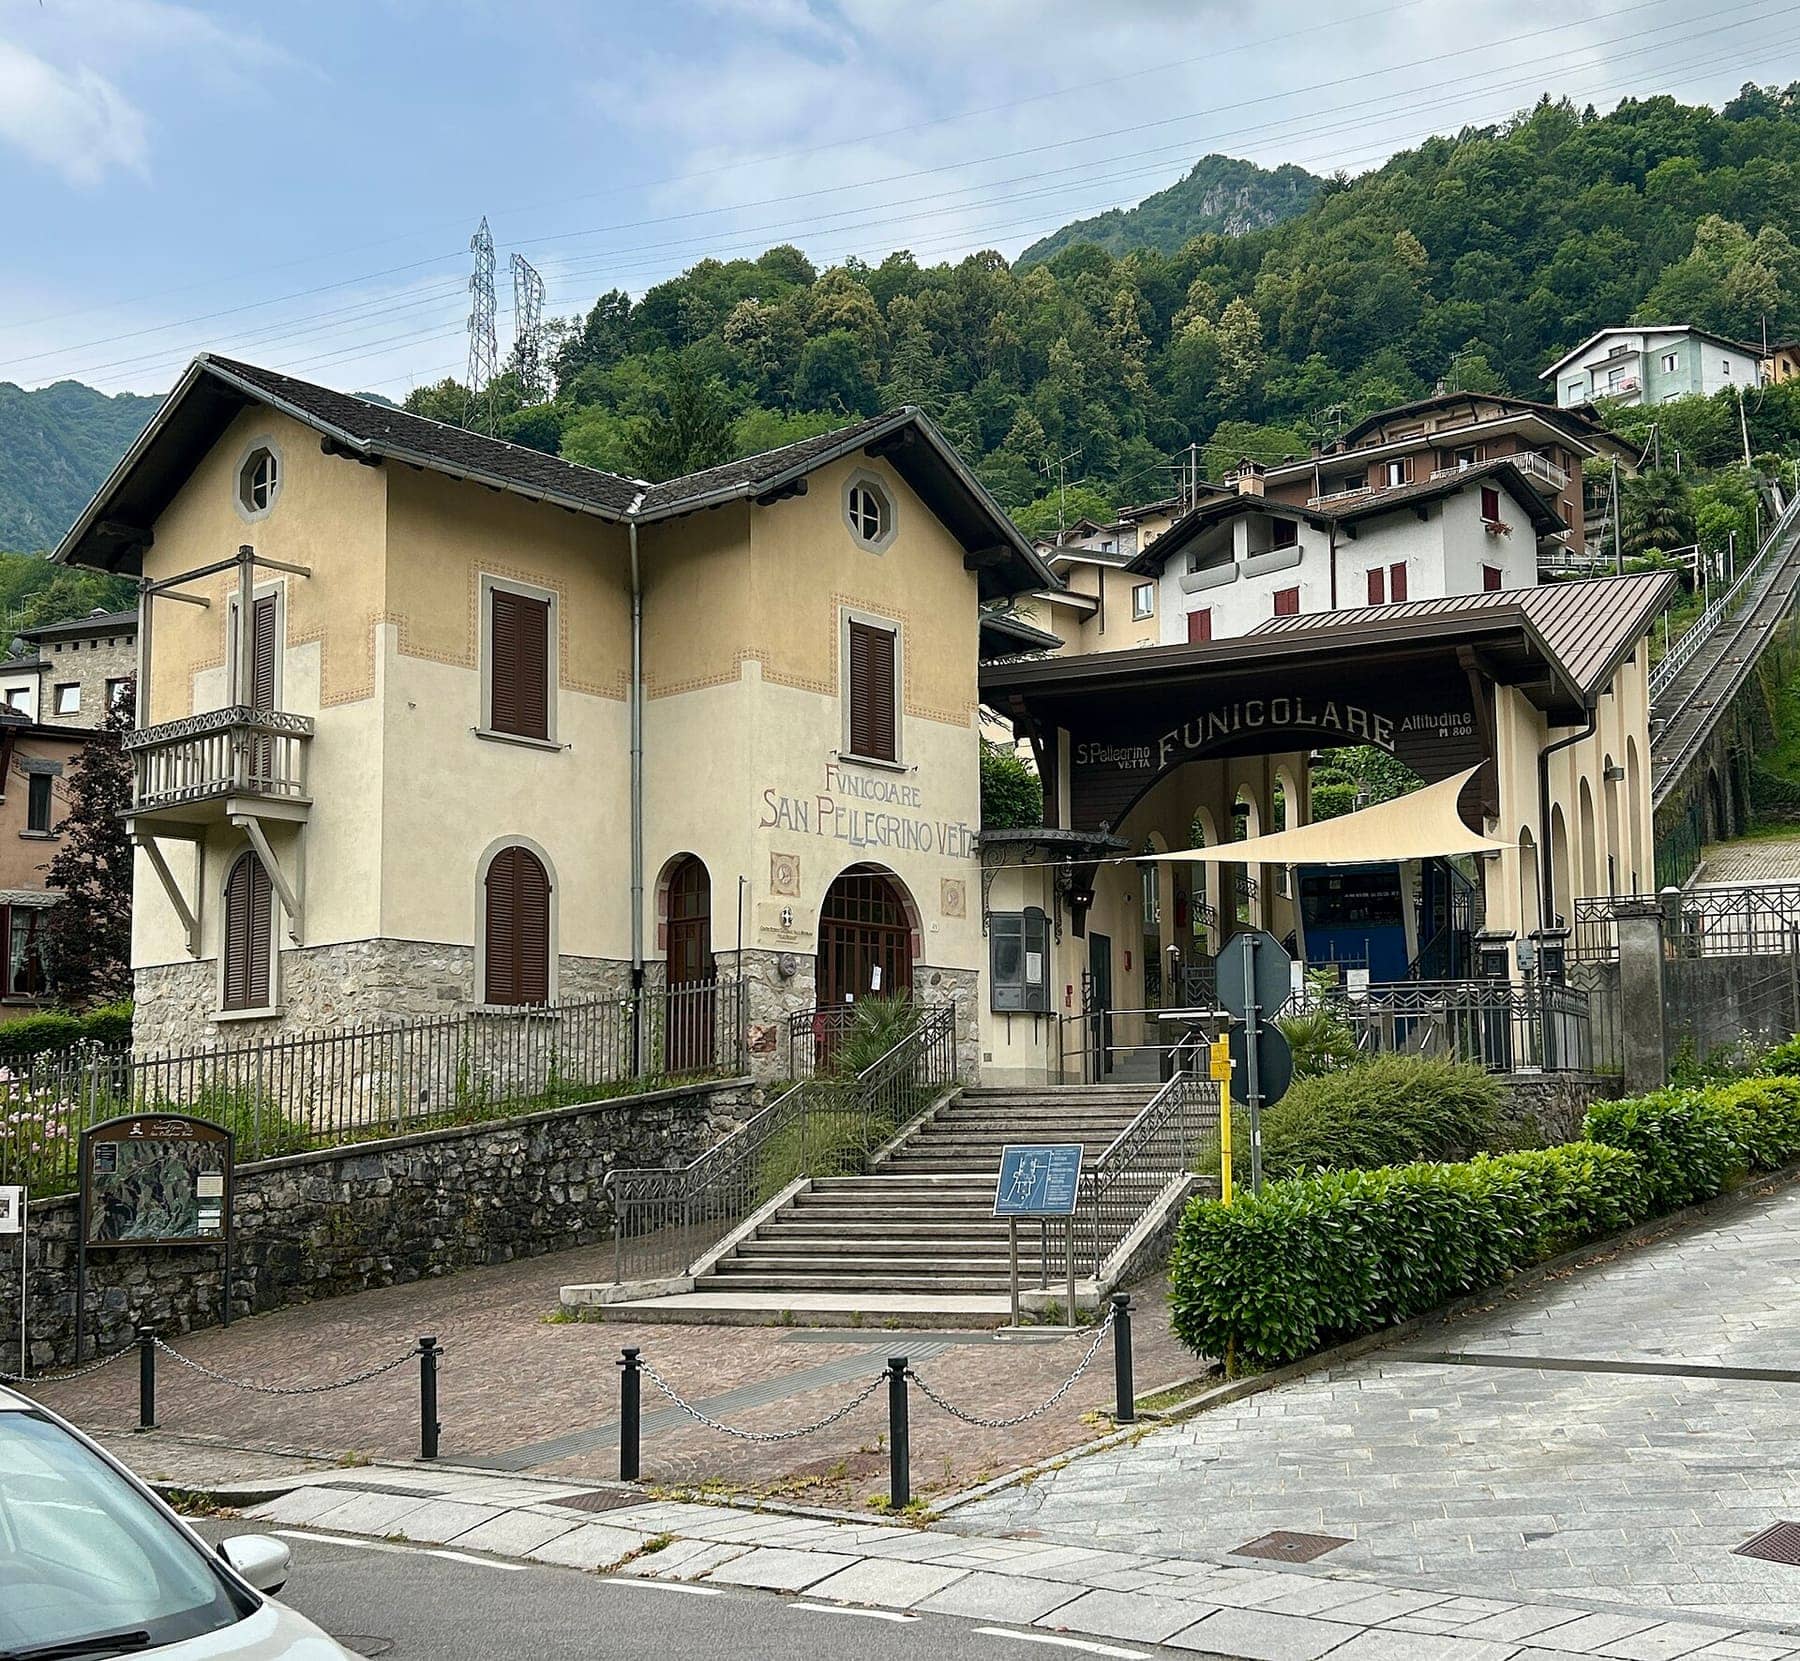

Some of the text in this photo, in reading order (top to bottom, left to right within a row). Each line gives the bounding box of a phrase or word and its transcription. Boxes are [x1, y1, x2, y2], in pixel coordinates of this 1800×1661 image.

[1401, 712, 1472, 732] Altitudine
[1452, 726, 1473, 736] 800
[1157, 697, 1395, 771] FUNICOLARE
[1118, 758, 1151, 770] VETTA
[758, 788, 810, 834] SAN
[815, 795, 933, 853] PELLEGRINO
